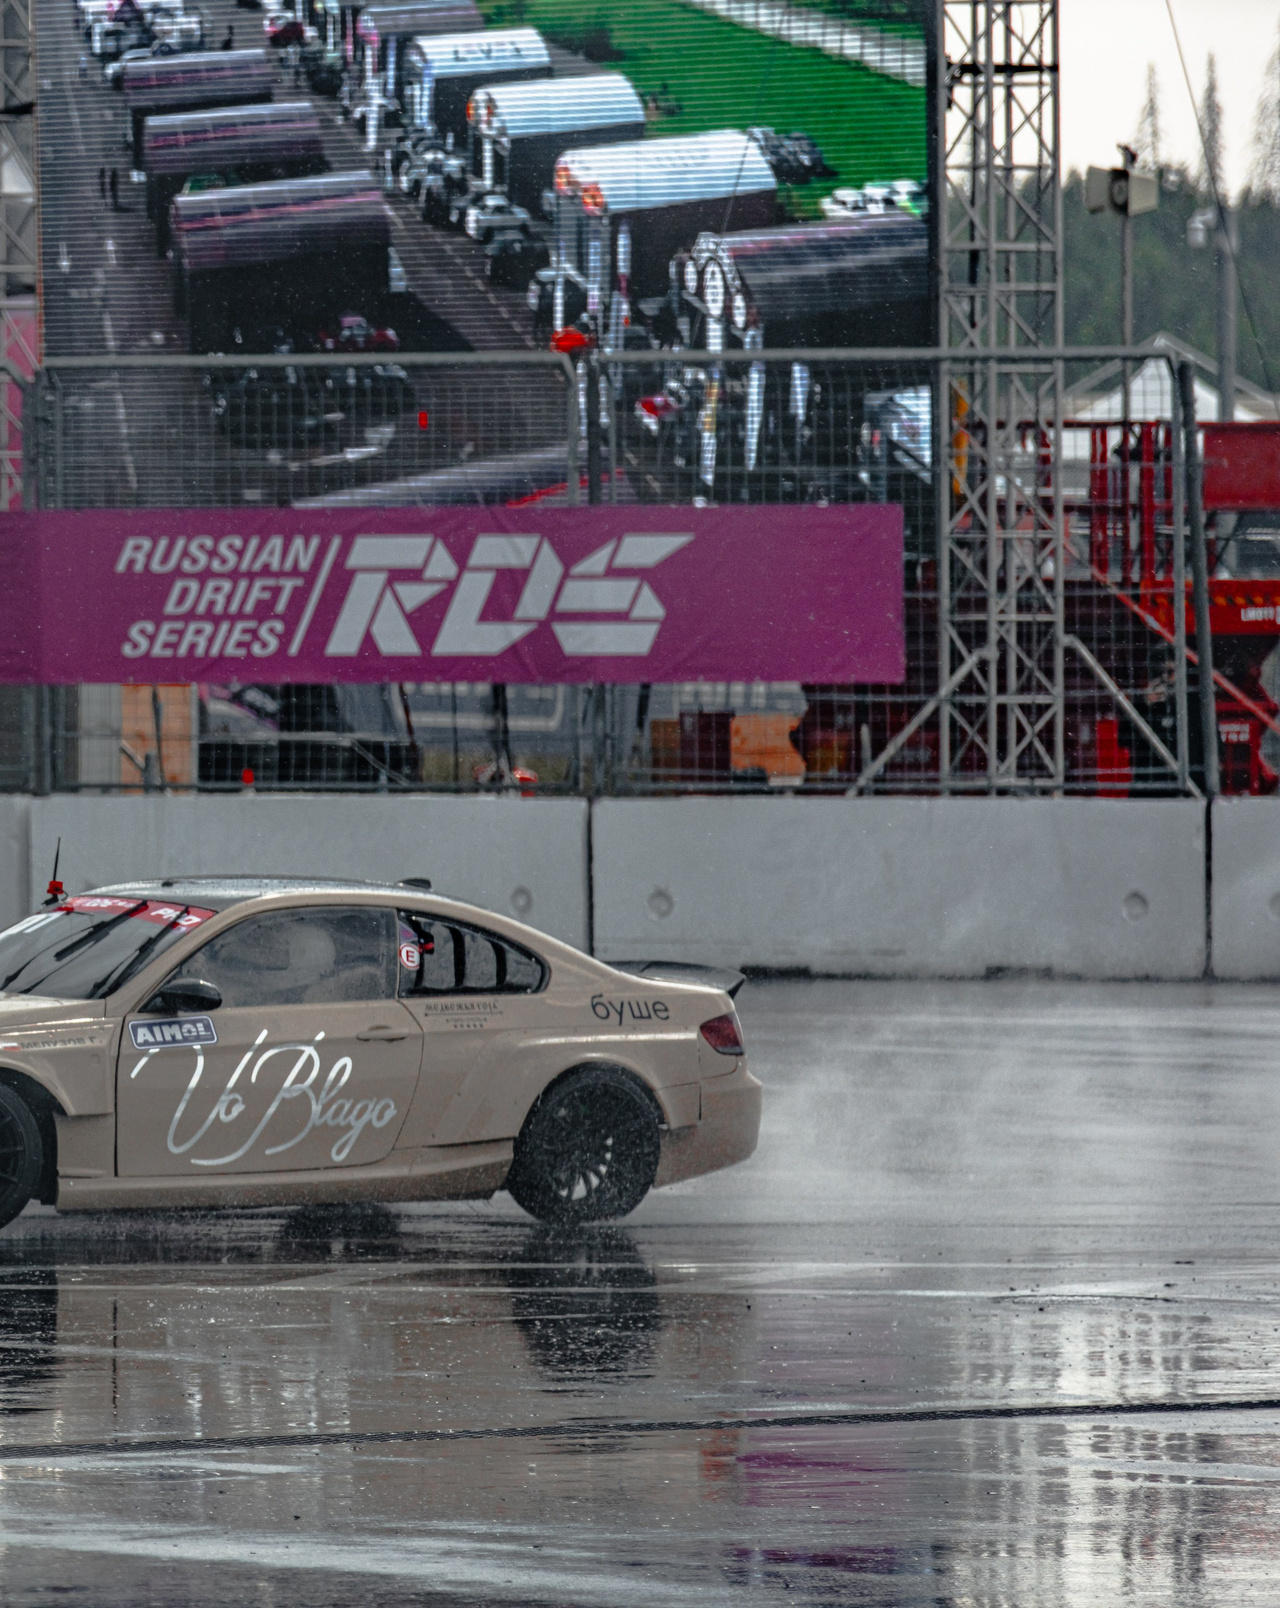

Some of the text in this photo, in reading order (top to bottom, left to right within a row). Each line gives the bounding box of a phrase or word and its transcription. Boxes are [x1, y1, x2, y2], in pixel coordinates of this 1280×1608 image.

[116, 535, 319, 573] RUSSIAN
[164, 578, 303, 615] DRIFT
[324, 533, 696, 656] RDS
[122, 620, 285, 657] SERIES
[590, 994, 669, 1026] буше
[136, 1022, 211, 1044] AIMOL
[191, 1031, 398, 1166] Blago
